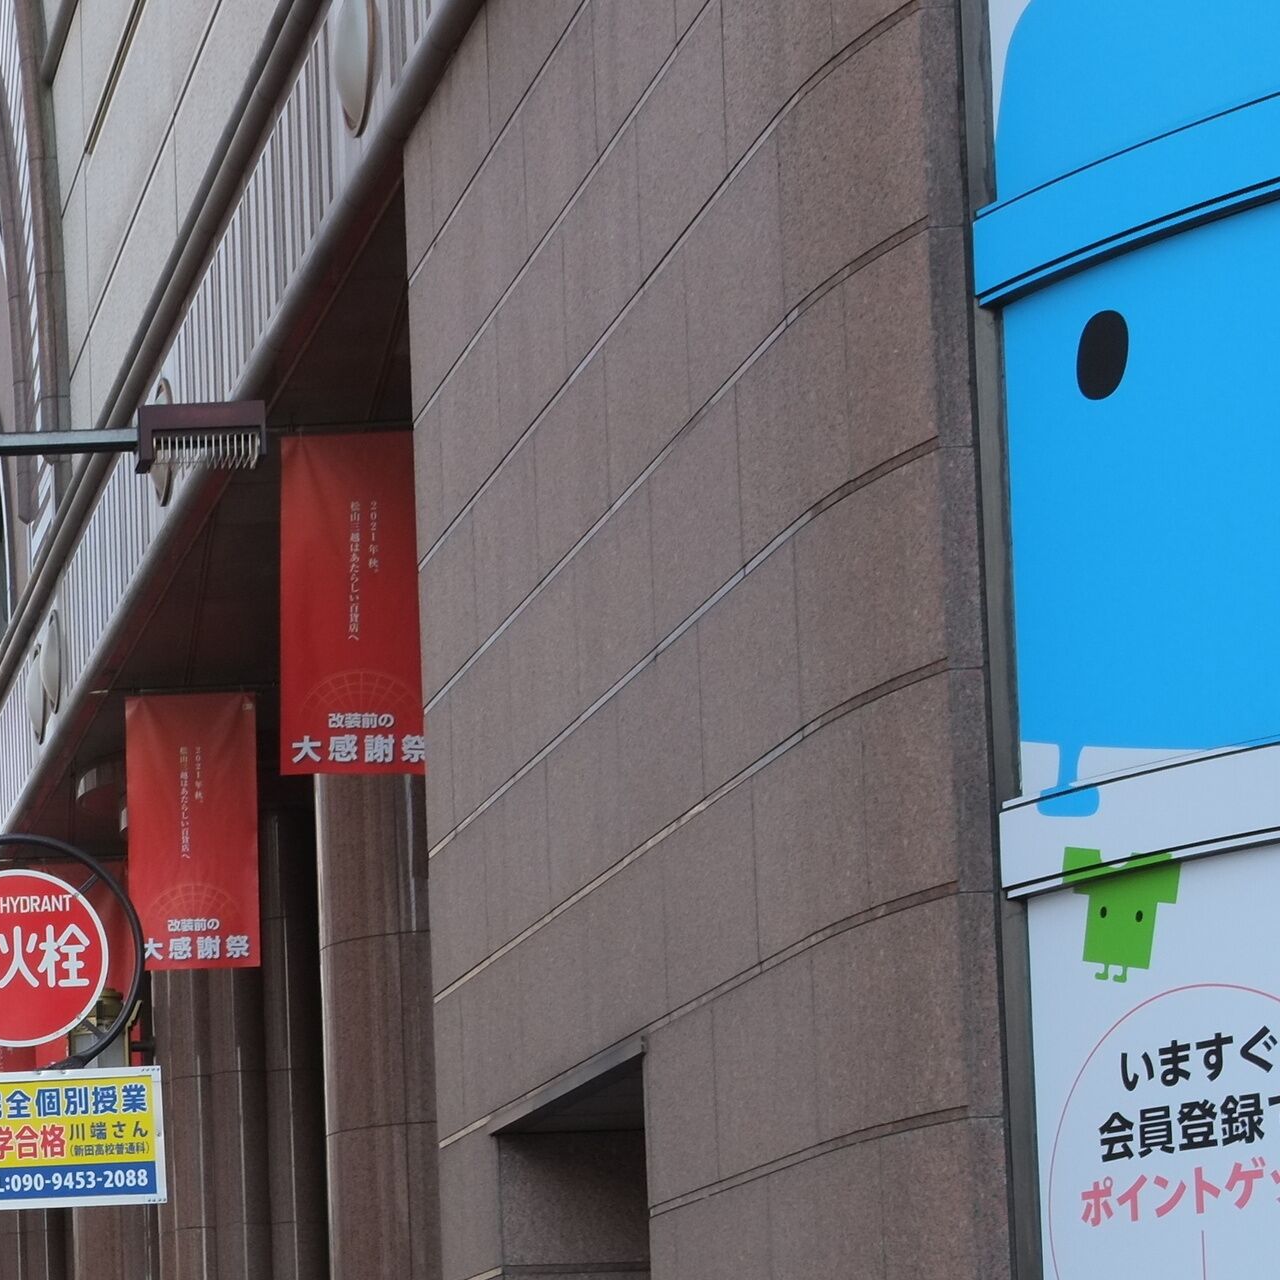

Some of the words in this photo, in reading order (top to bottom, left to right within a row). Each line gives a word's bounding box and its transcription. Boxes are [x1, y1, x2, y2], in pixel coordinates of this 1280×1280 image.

[327, 712, 395, 729] 改装前の
[291, 734, 426, 764] 大感謝祭
[0, 894, 73, 914] HYDRANT
[167, 917, 220, 932] 改装前の
[144, 934, 251, 961] 大感謝祭
[1120, 1025, 1279, 1093] いますぐ
[69, 1120, 148, 1141] 川端さん
